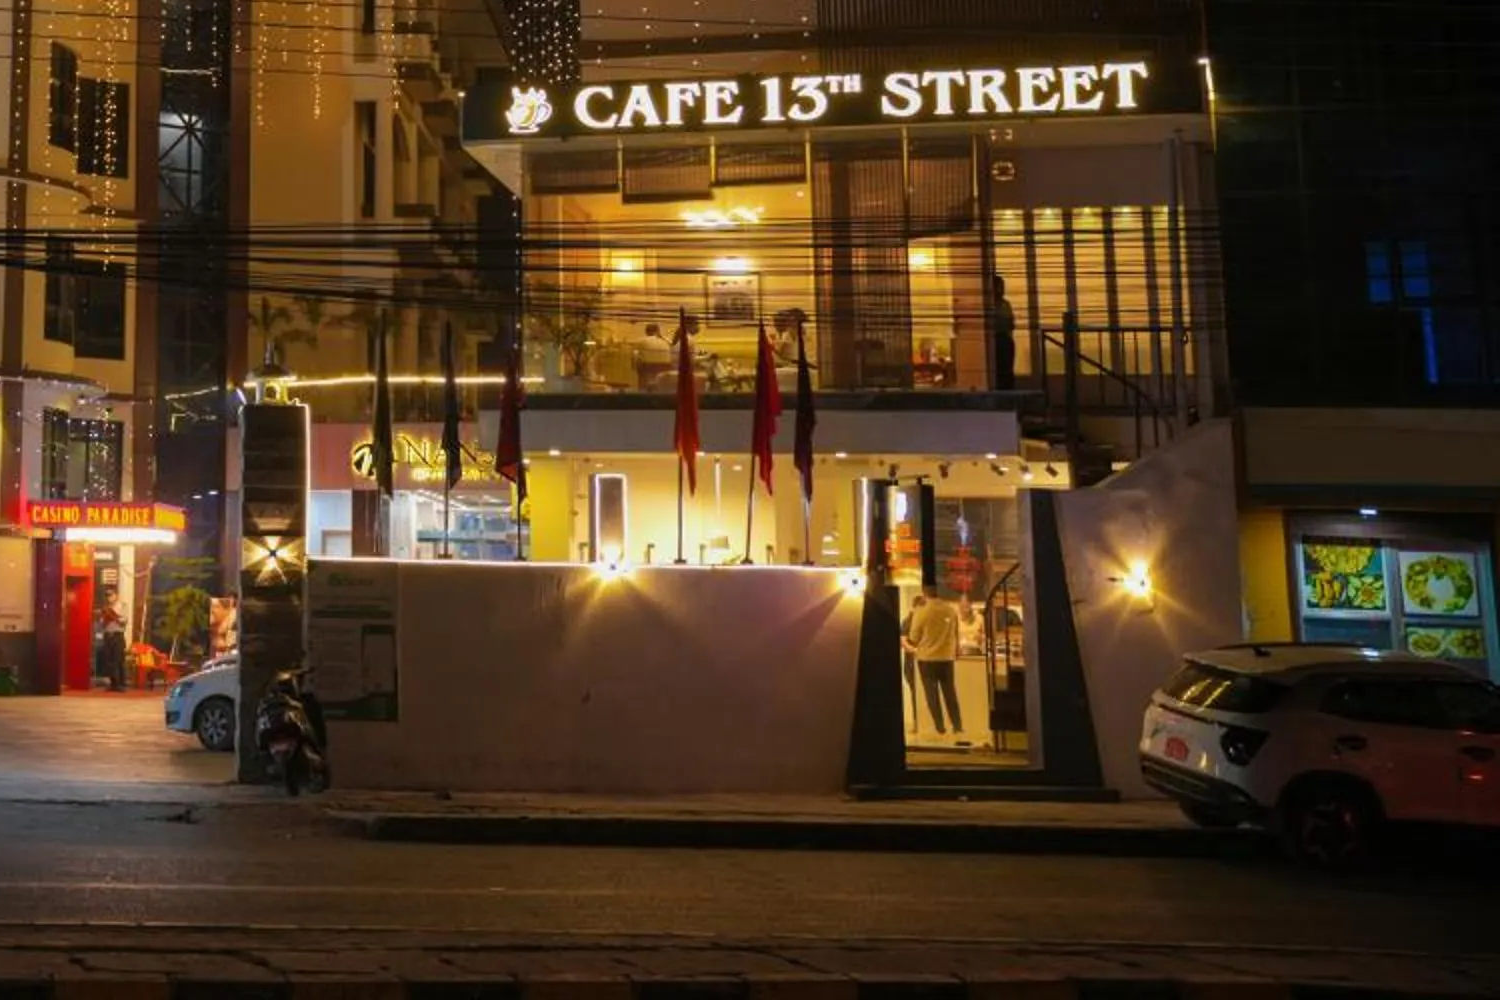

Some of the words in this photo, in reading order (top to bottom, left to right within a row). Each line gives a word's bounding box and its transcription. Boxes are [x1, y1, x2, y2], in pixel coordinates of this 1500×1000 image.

[574, 80, 744, 129] CAFE
[880, 63, 1148, 117] STREET
[32, 505, 81, 524] CASINO
[87, 506, 150, 526] PARADISE
